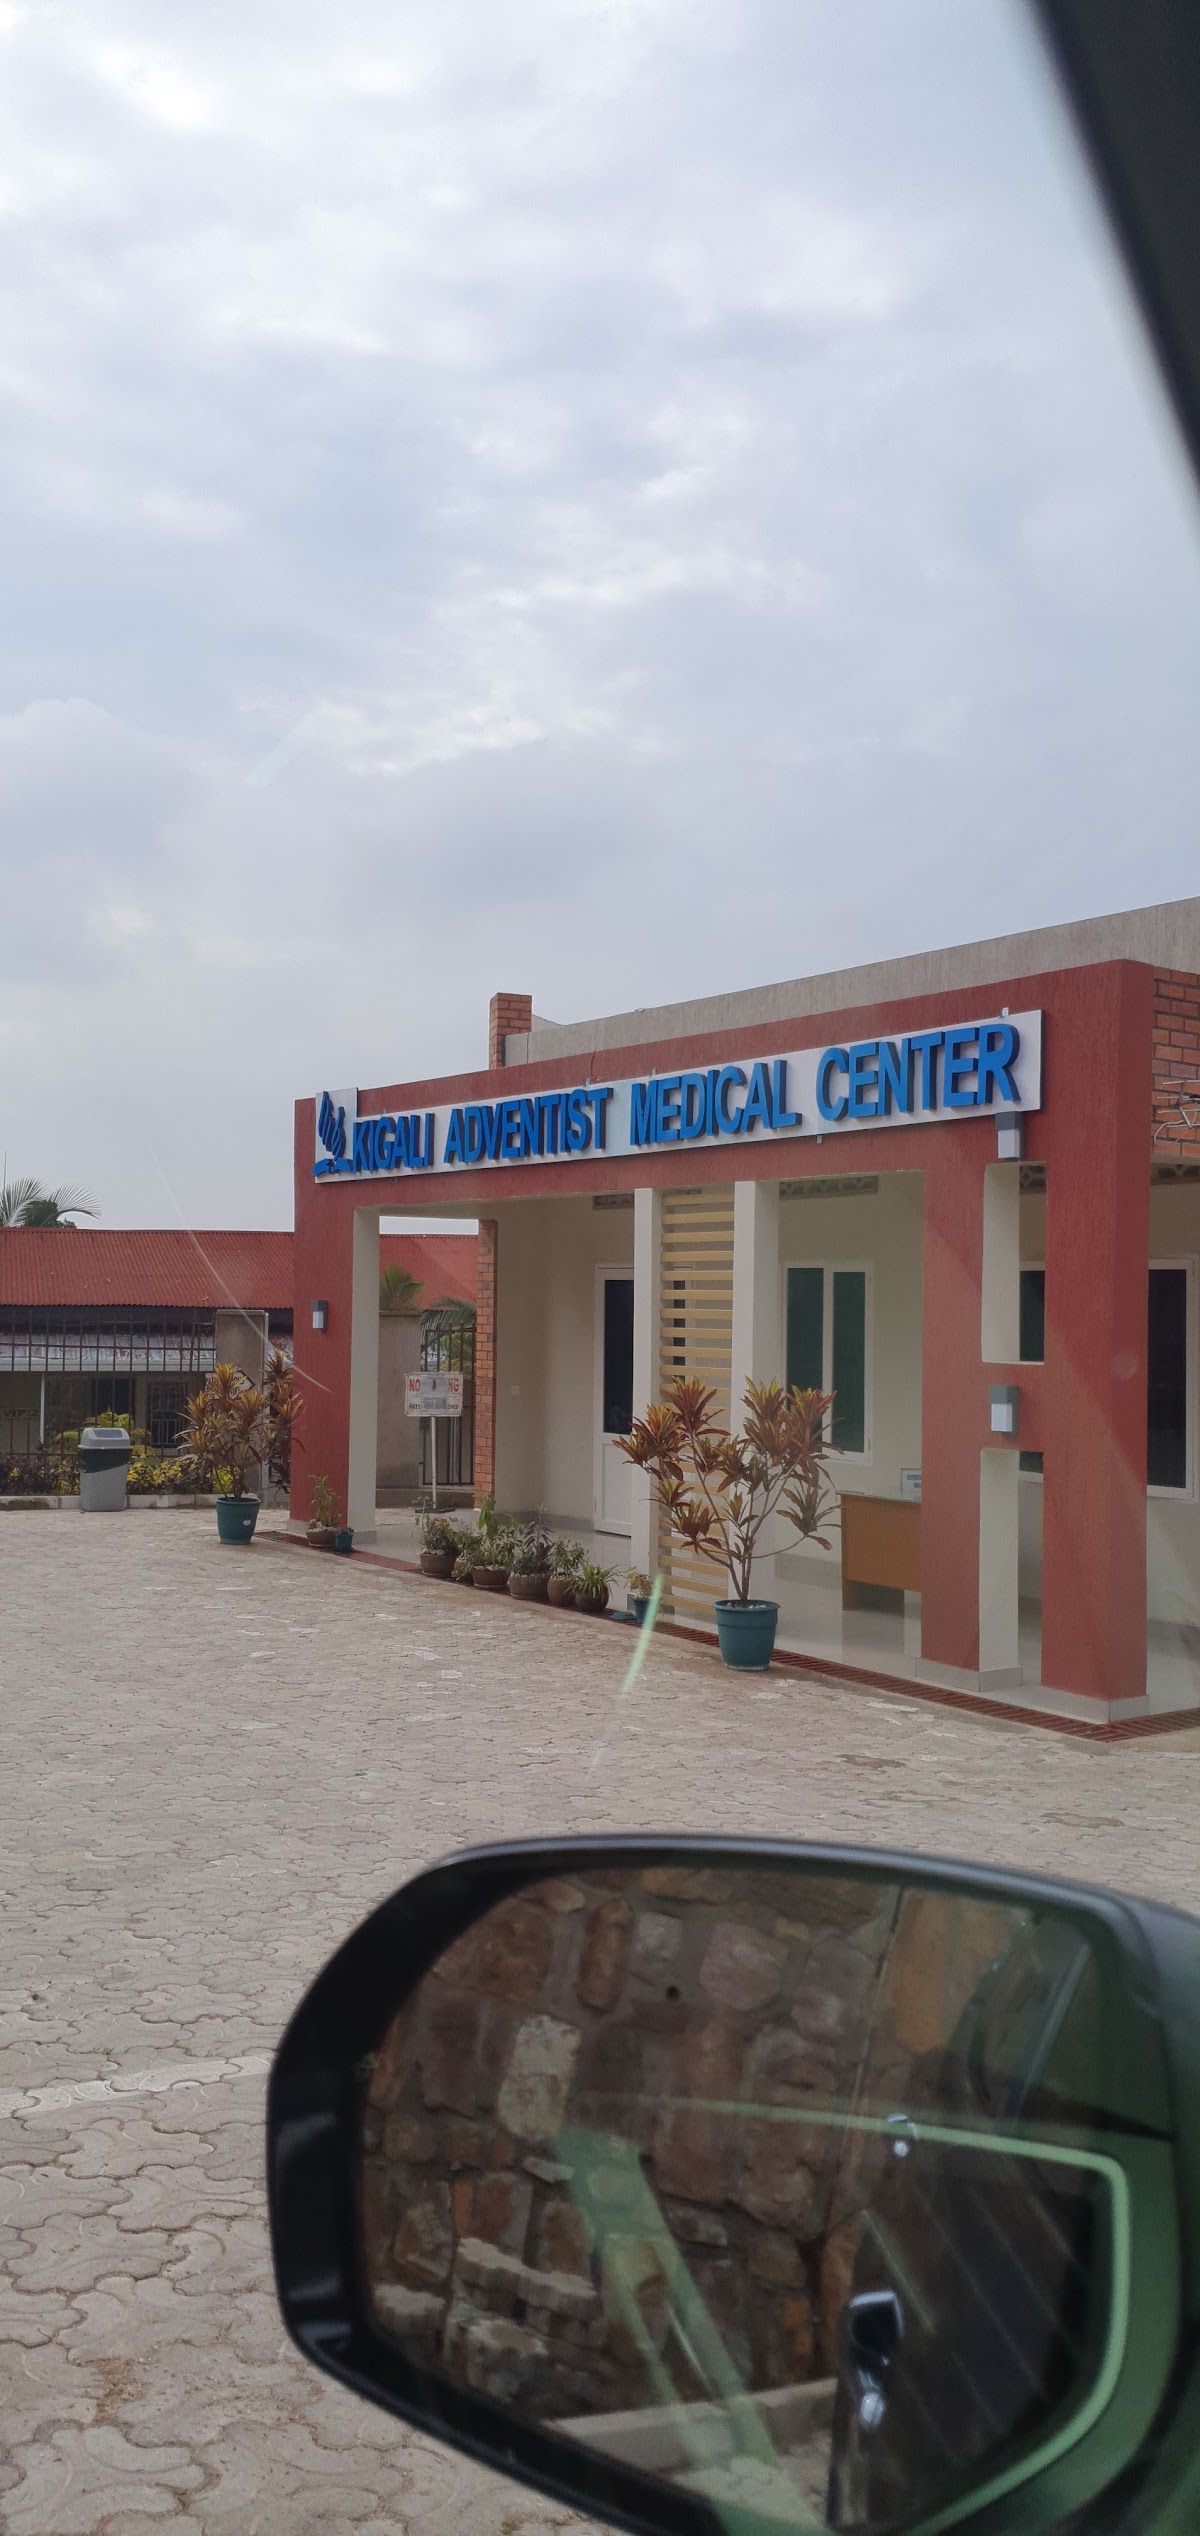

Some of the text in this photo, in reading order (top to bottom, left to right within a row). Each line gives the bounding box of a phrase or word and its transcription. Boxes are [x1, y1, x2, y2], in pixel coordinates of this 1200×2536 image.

[352, 1023, 1021, 1172] KIGALI ADVENTIST MEDICAL CENTER
[408, 1378, 421, 1392] NO
